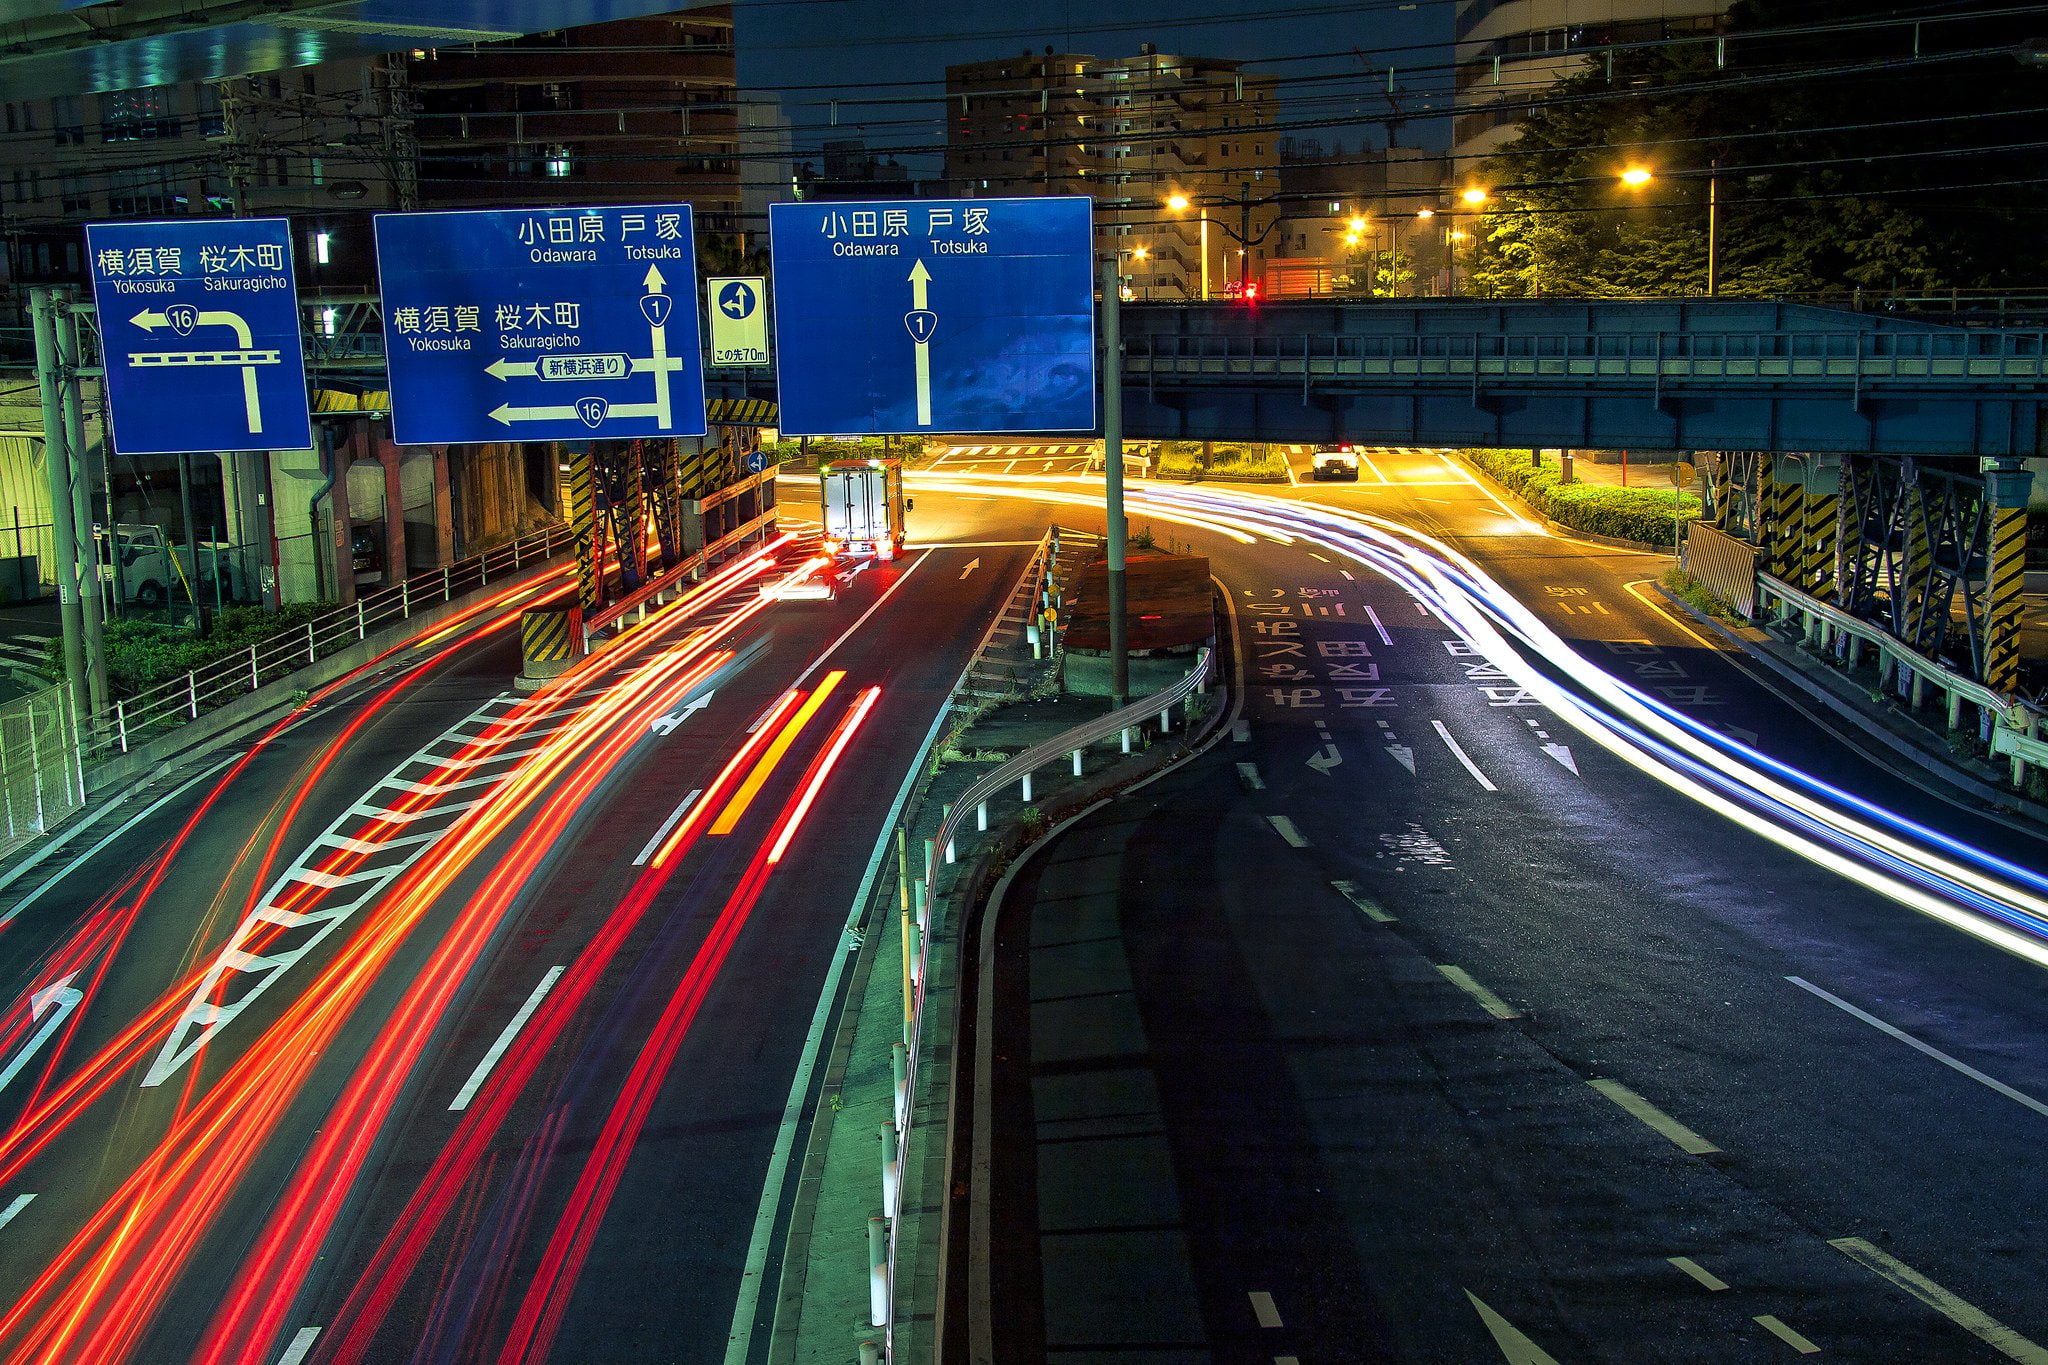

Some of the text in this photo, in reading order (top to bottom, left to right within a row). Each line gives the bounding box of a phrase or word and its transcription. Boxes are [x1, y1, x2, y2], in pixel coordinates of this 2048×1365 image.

[518, 213, 682, 245] 小田原 戸塚
[821, 208, 991, 238] 小田原 戸塚
[530, 244, 681, 263] Odawara Totsuka
[833, 239, 988, 257] Odawara Totsuka
[98, 243, 283, 277] 横須賀 桜木町
[113, 275, 287, 294] Yokosuka Sakuragicho
[171, 309, 192, 328] 16
[394, 302, 580, 335] 横須賀 桜木町
[651, 300, 660, 318] 1
[915, 316, 925, 335] 1
[408, 333, 581, 352] Yokosuka Sakuragicho
[716, 347, 766, 363] この先70m
[549, 357, 619, 376] 新横浜通り
[583, 402, 601, 421] 16
